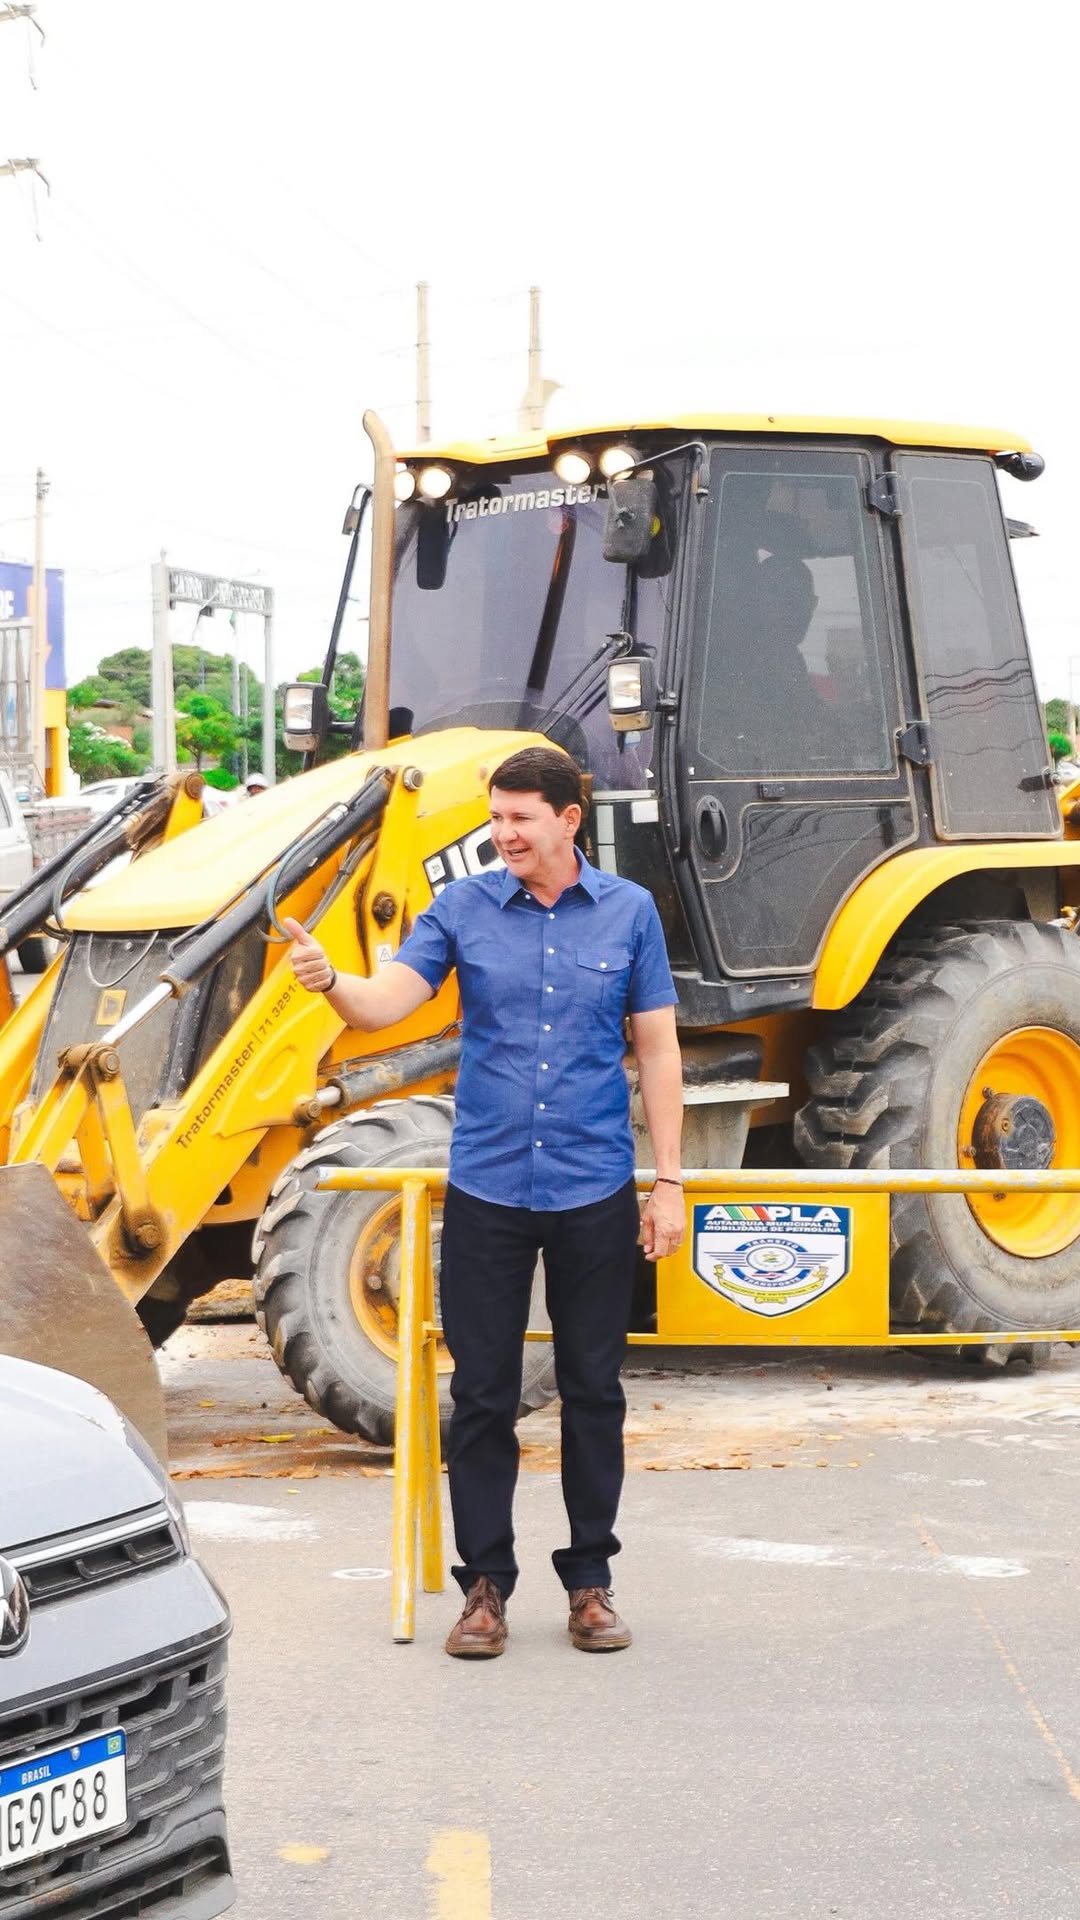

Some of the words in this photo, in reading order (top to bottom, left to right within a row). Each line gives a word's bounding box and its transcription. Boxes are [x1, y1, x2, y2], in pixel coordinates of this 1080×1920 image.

[445, 483, 607, 523] Tratormaster
[176, 1040, 255, 1150] Tratormaster
[258, 1018, 273, 1035] 71
[21, 1765, 51, 1786] BRASIL
[0, 1770, 107, 1857] G9C88
